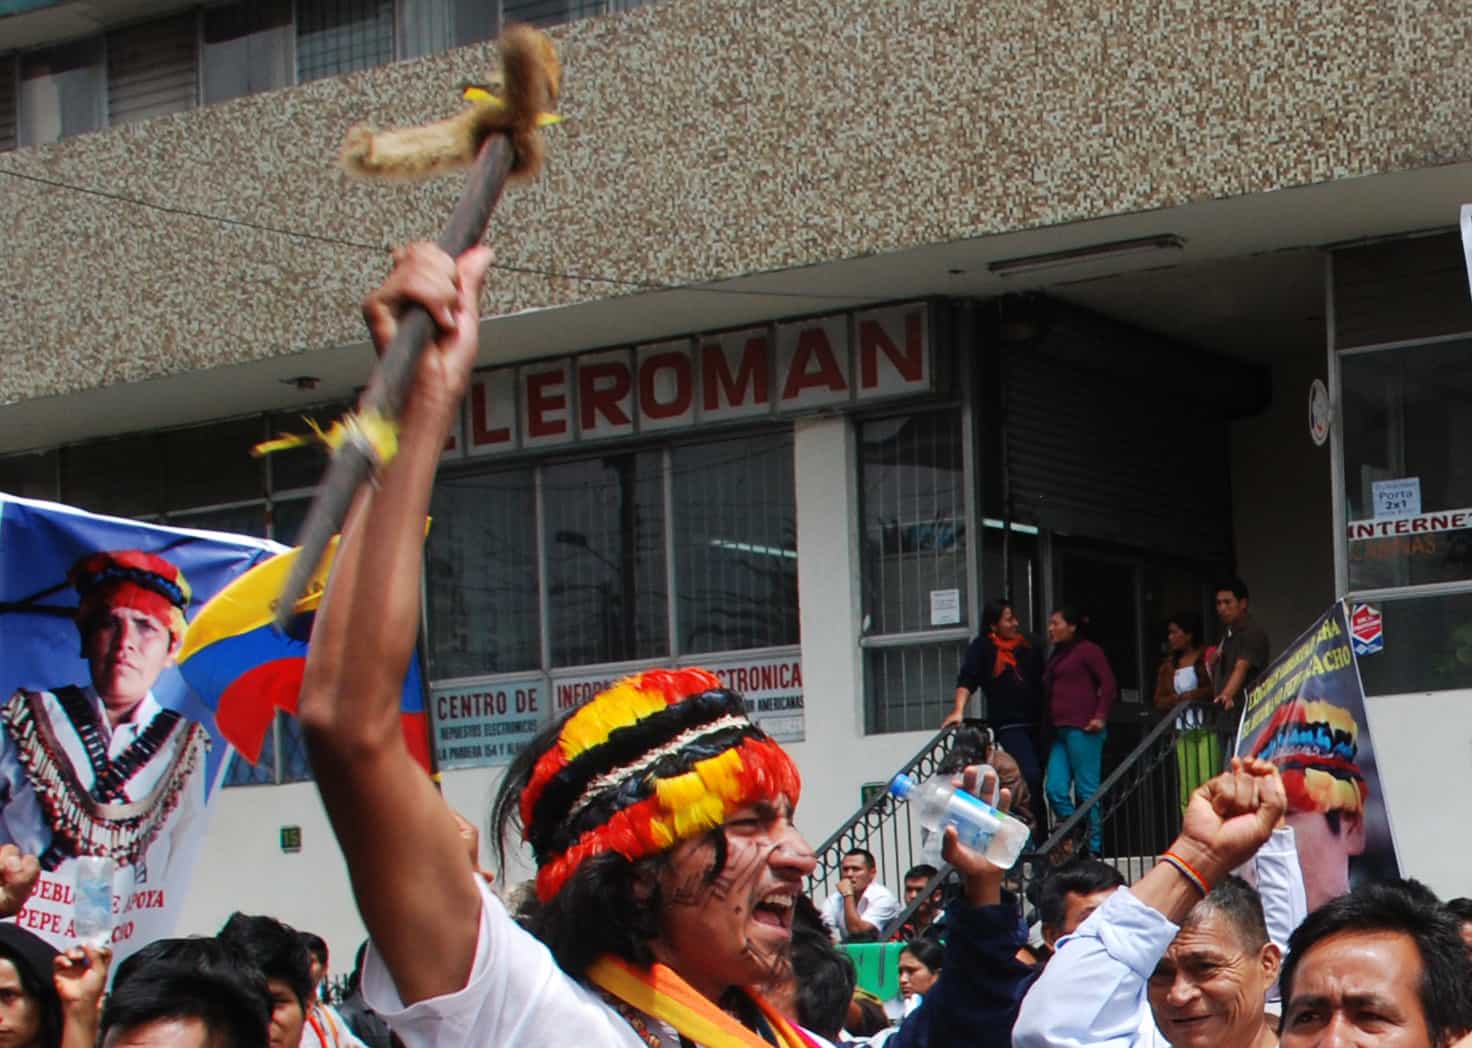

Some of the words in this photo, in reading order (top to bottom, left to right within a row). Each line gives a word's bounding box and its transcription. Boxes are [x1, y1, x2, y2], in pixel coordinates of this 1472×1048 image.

[444, 311, 924, 450] LEROMAN
[437, 690, 507, 720] CENTRO
[515, 688, 538, 713] DE
[15, 908, 61, 934] PEPE
